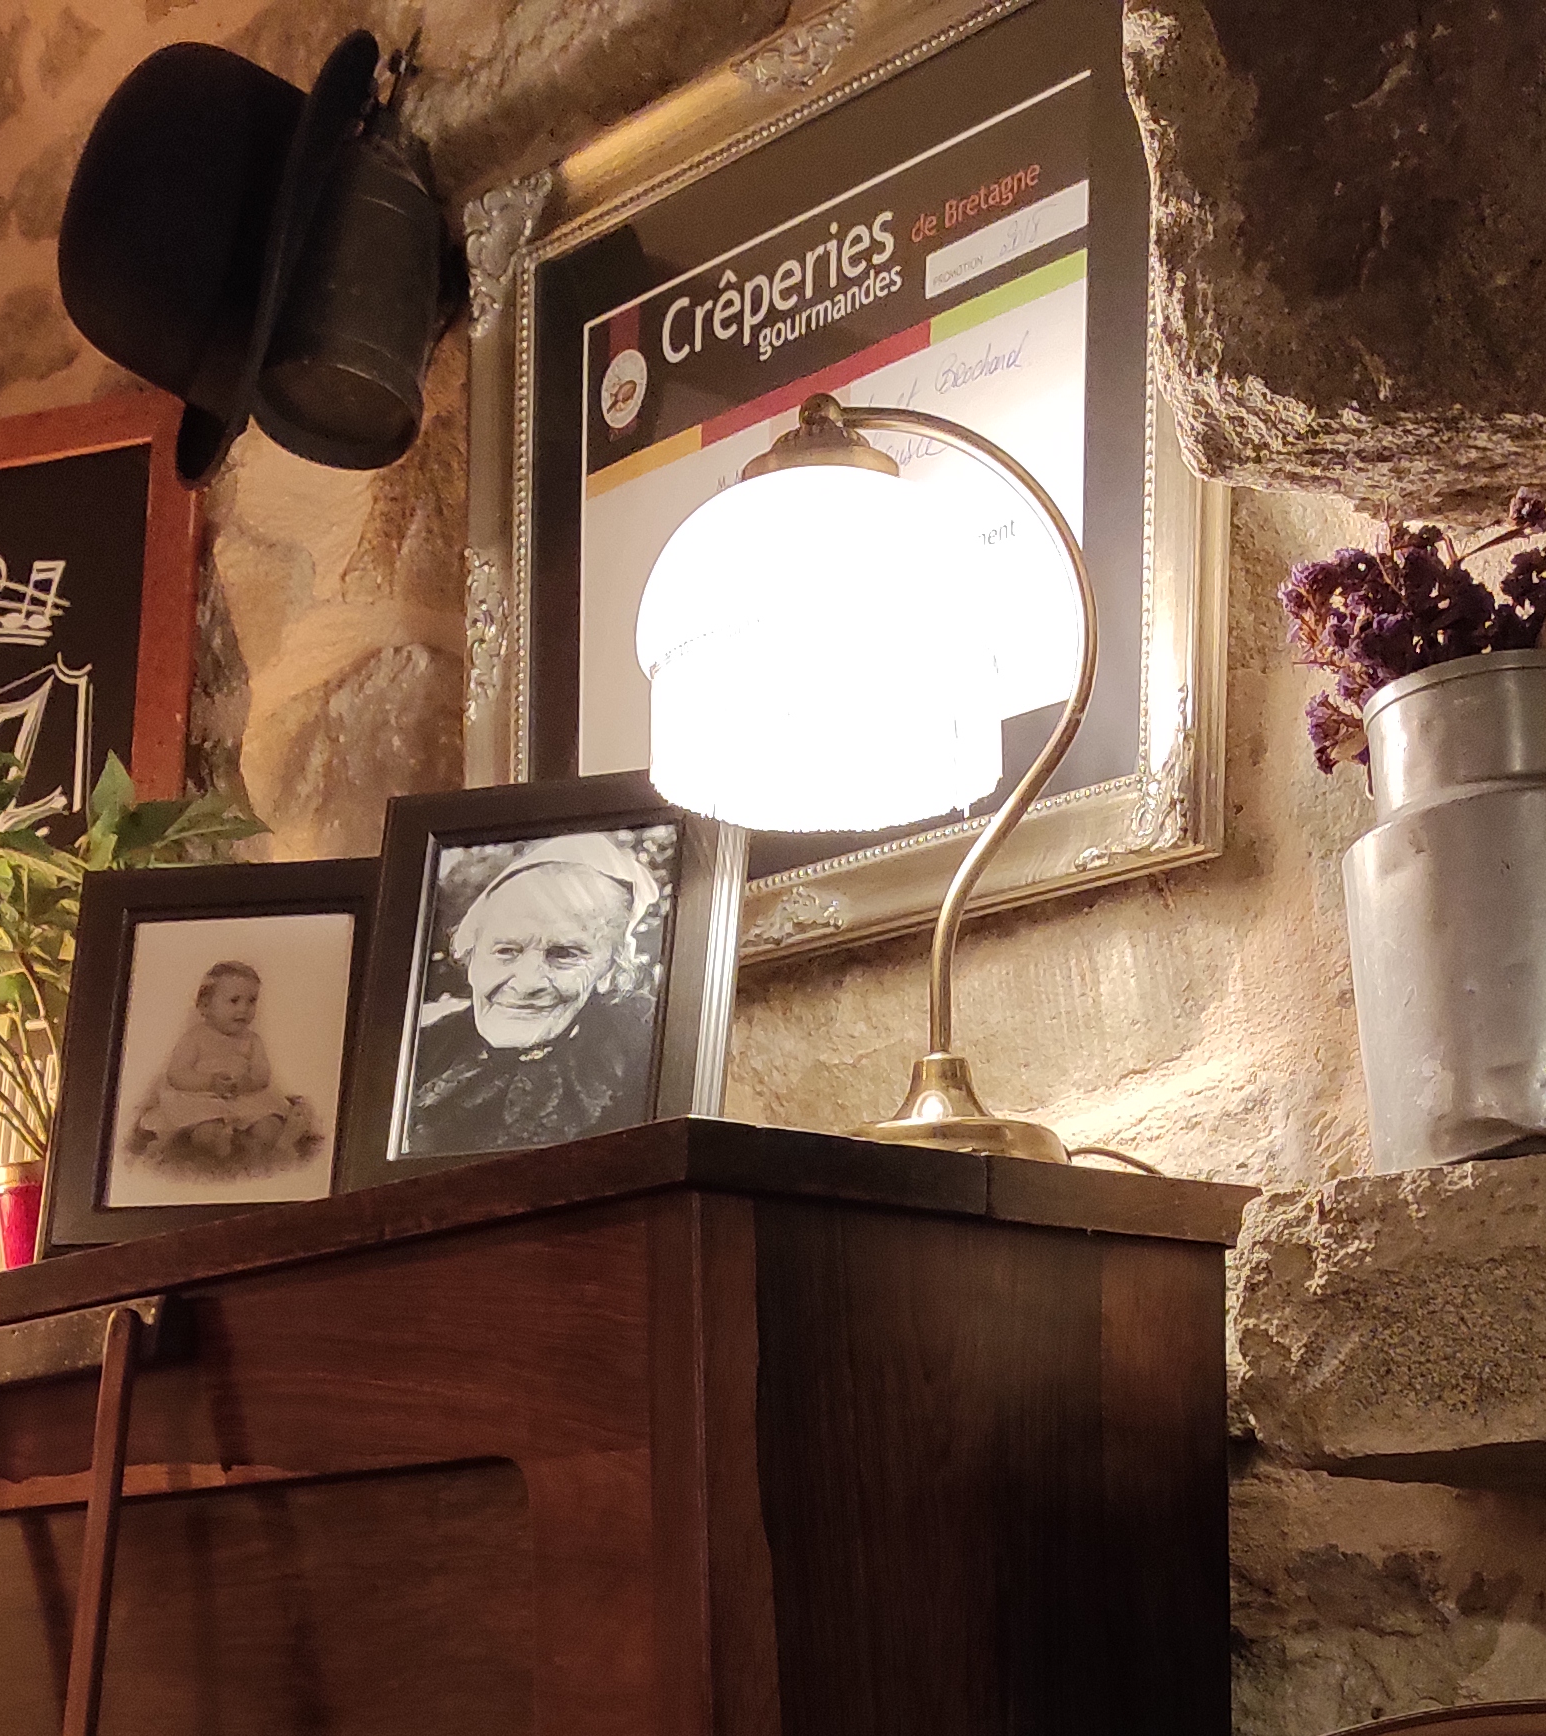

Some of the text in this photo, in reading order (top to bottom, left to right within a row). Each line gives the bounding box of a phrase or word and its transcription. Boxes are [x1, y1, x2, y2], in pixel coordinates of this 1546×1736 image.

[662, 164, 1039, 363] Crêperies de Bretagne
[759, 266, 902, 361] gourmandes
